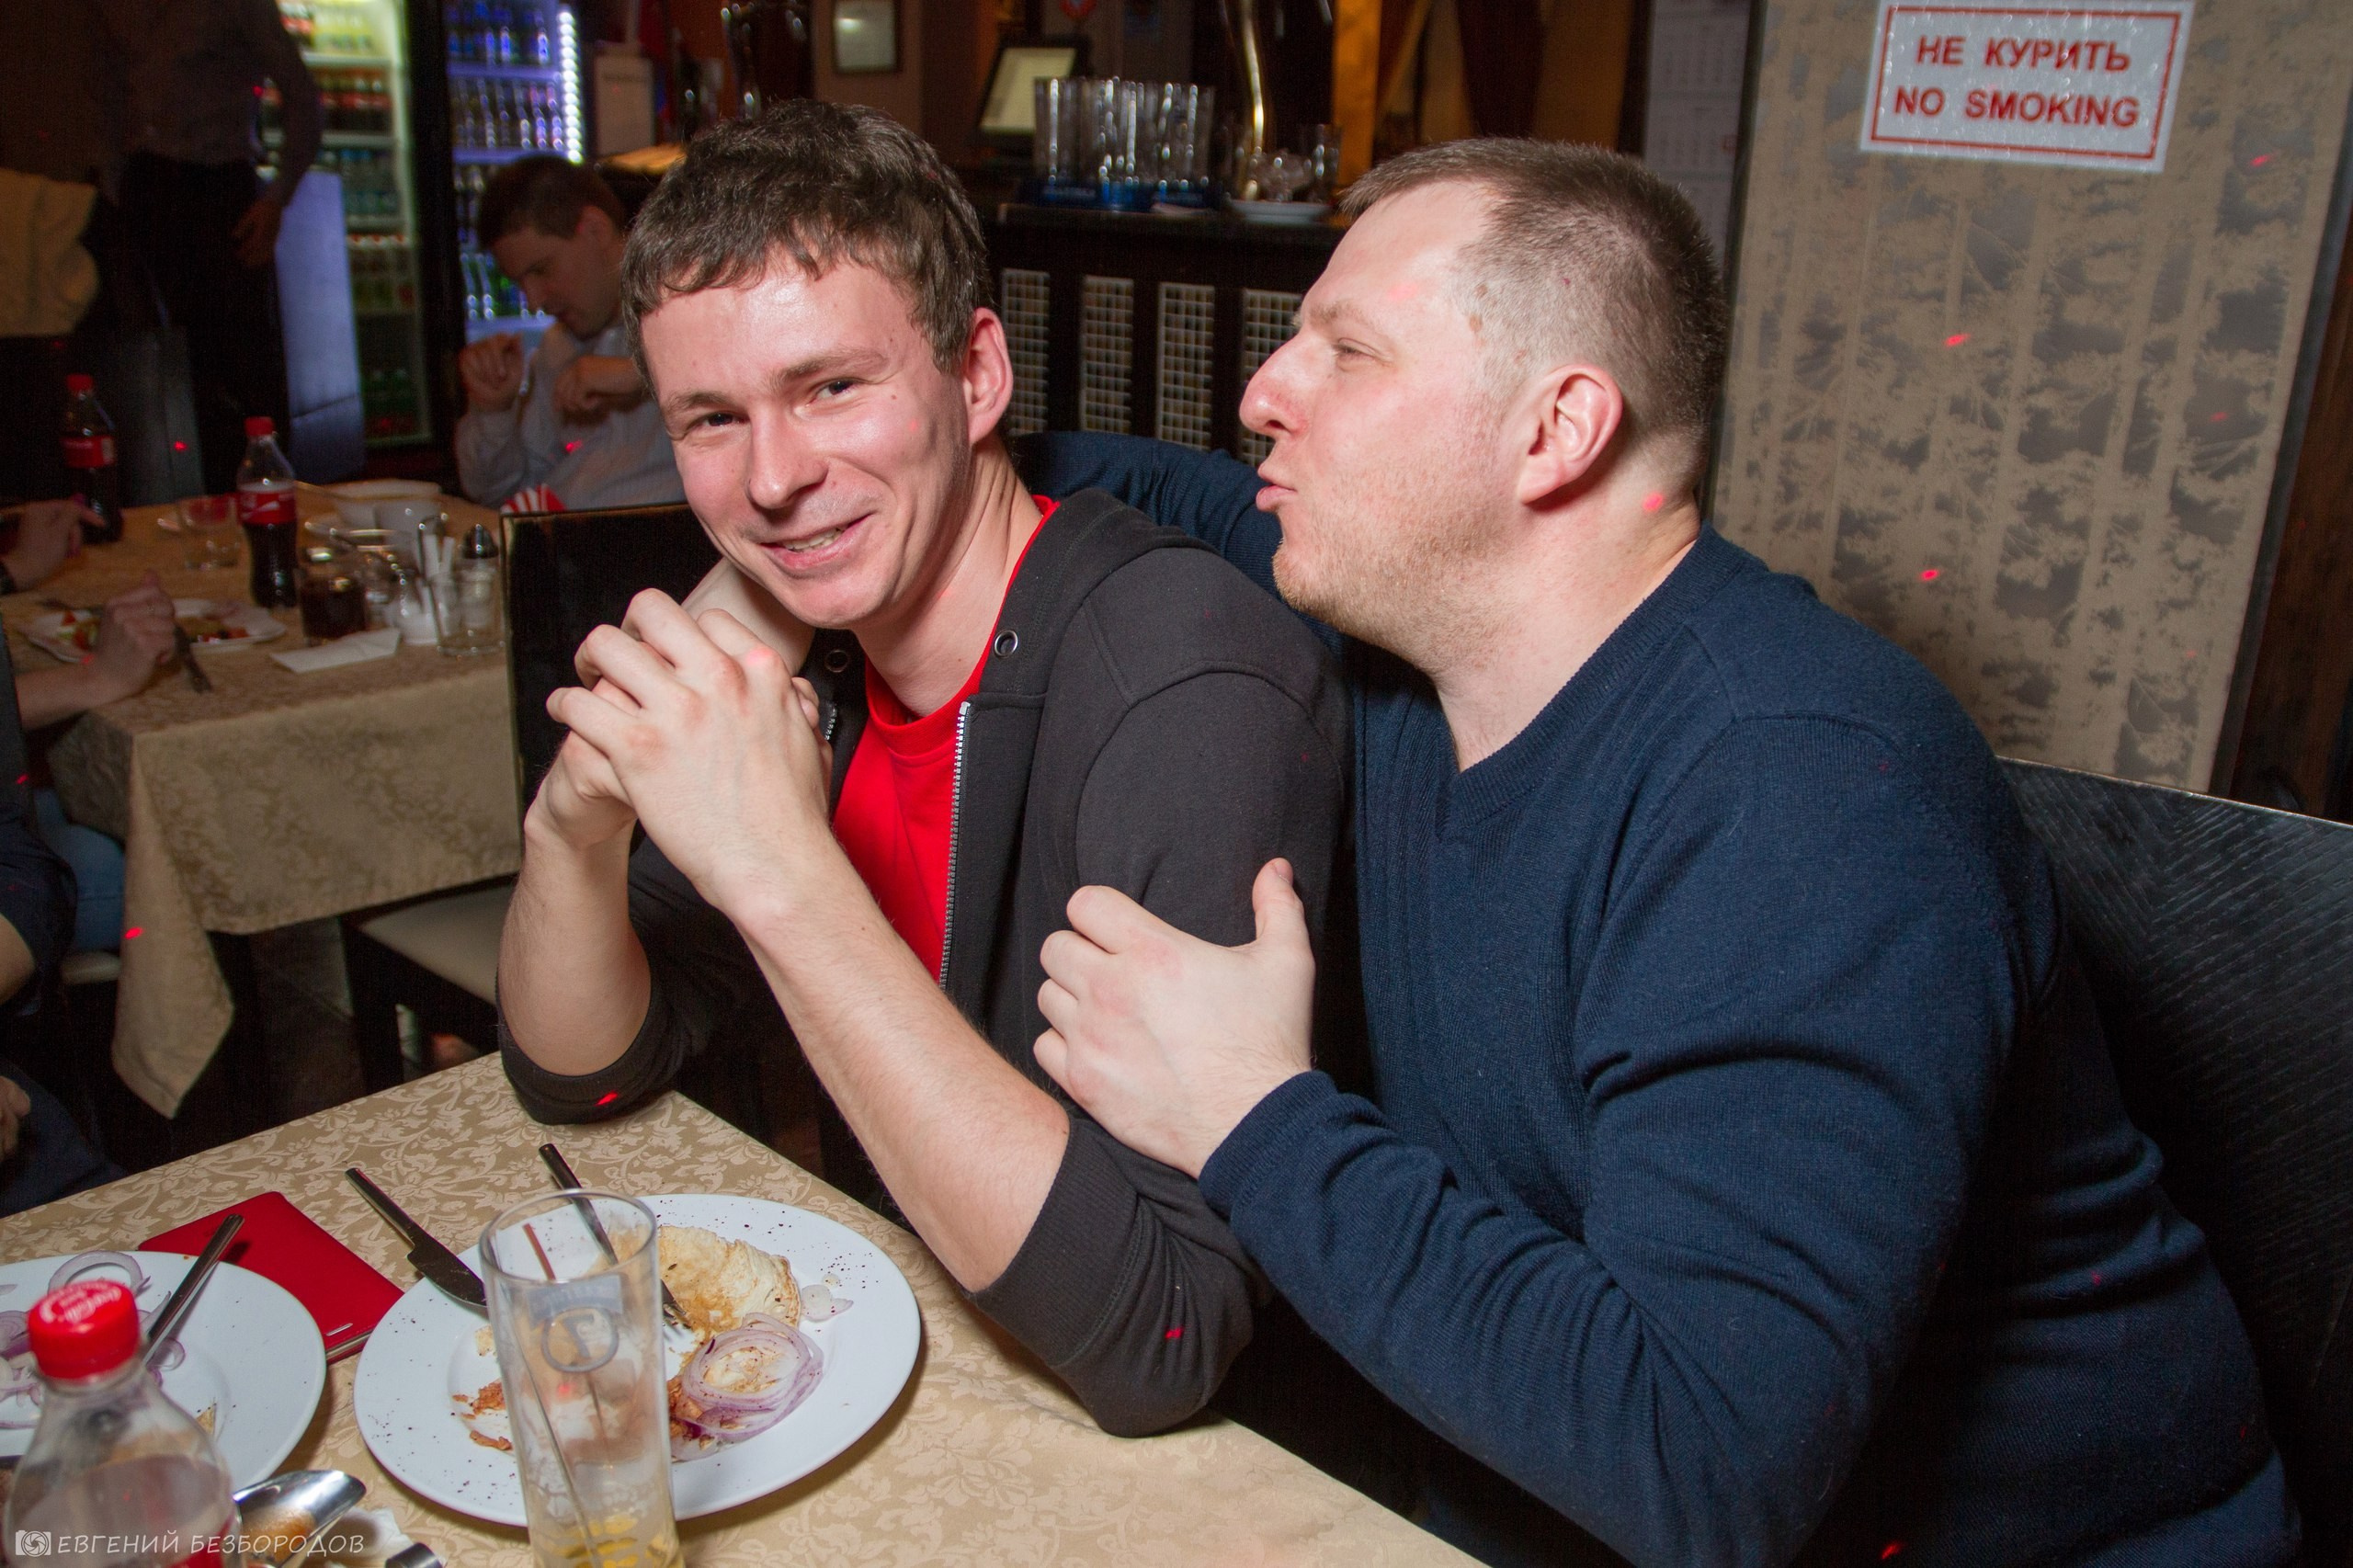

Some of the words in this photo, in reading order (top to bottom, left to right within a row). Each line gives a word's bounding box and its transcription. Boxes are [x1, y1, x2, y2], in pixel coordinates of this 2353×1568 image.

[1915, 36, 1966, 66] НЕ
[1984, 37, 2131, 73] КУРИТЬ
[1893, 85, 1946, 117] NO
[1965, 88, 2141, 128] SMOKING
